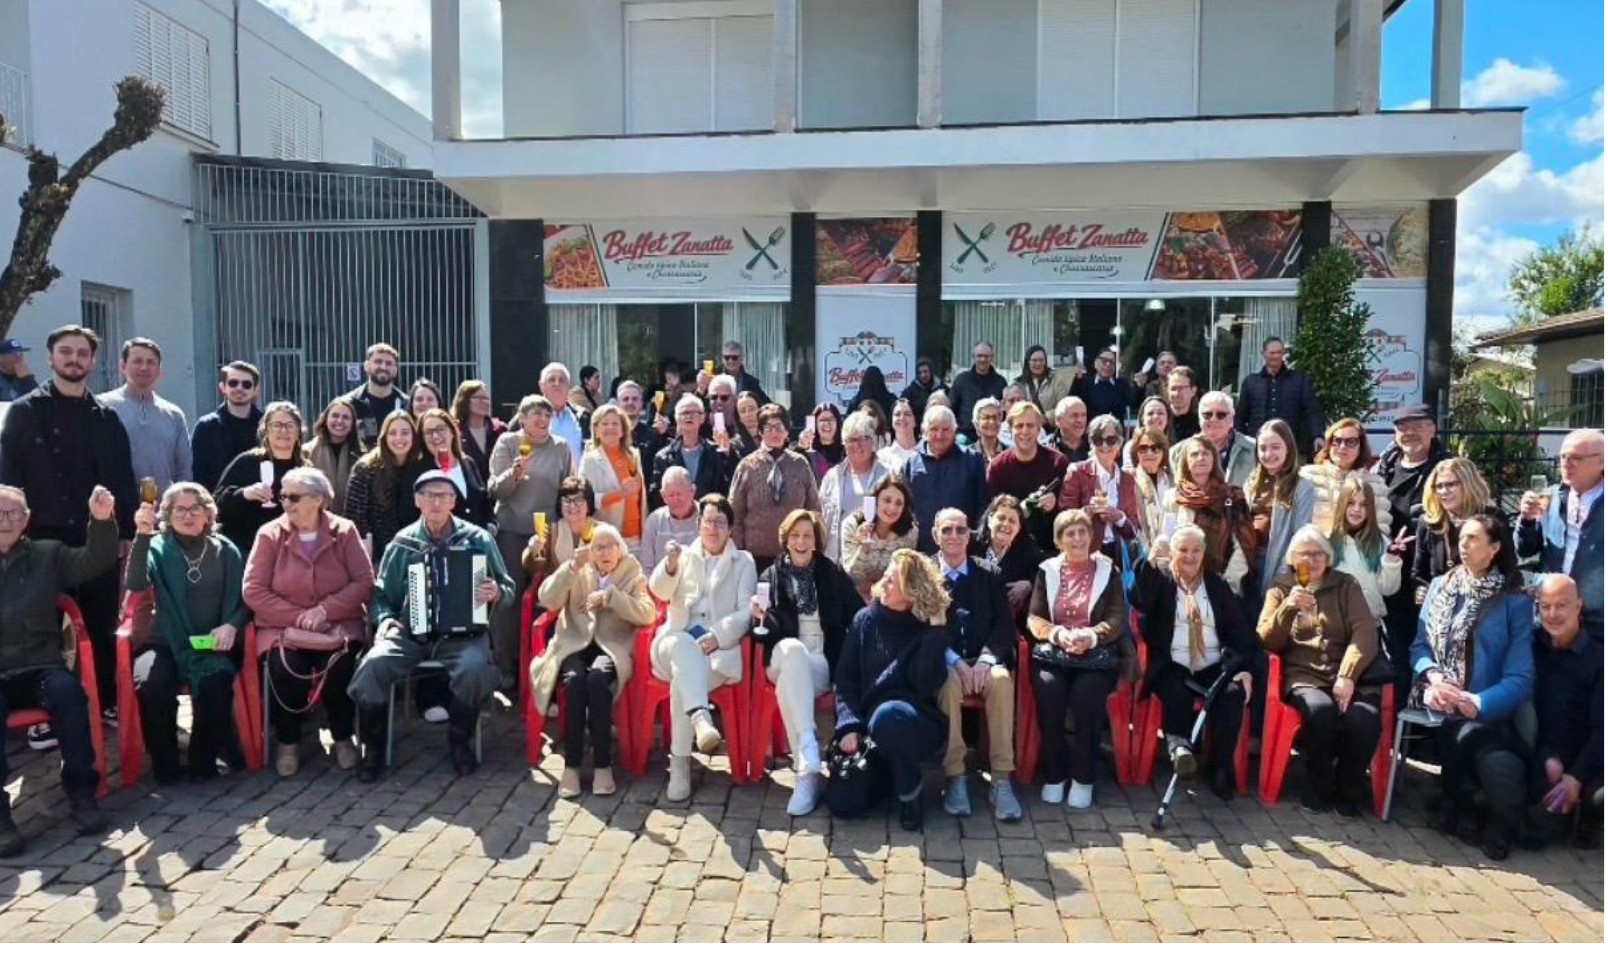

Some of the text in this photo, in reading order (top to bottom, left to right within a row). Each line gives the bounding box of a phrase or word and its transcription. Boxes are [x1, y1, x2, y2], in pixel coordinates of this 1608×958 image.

[603, 230, 734, 259] Buffet Zanatta
[1005, 222, 1149, 253] Buffet Zanatta
